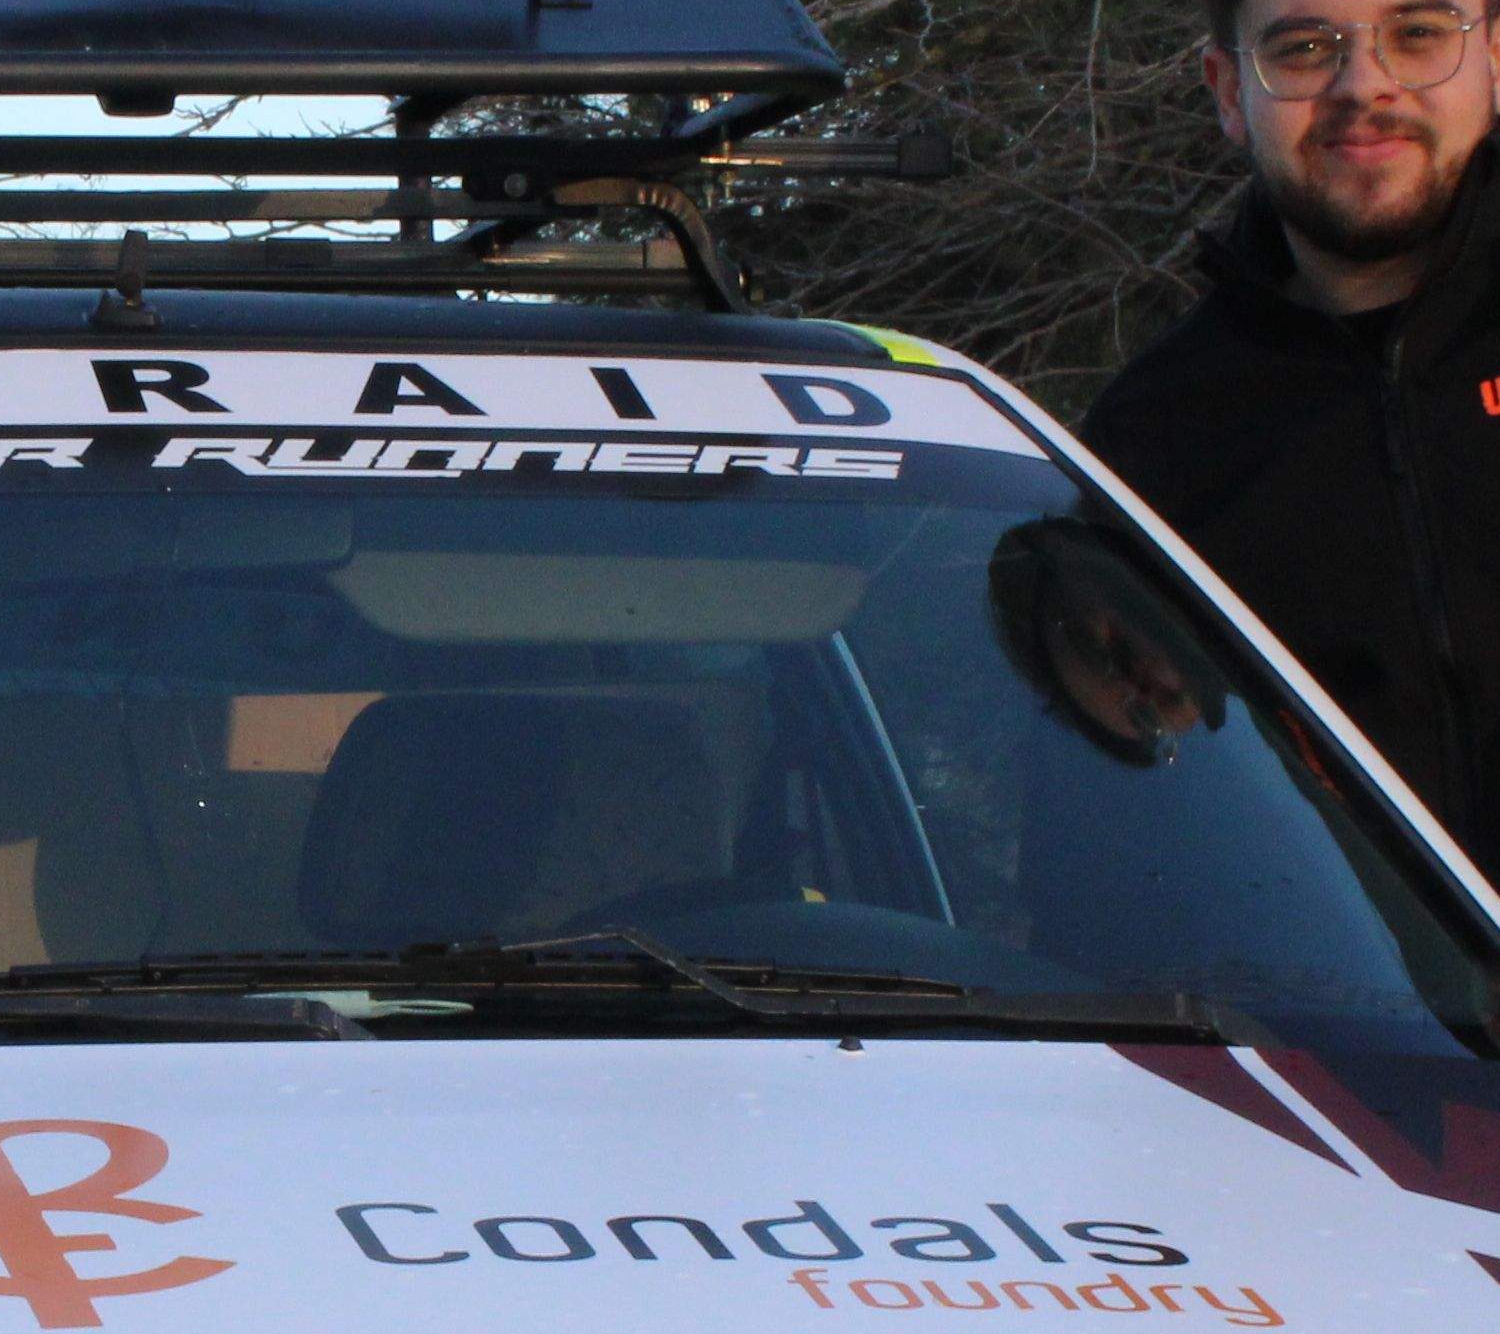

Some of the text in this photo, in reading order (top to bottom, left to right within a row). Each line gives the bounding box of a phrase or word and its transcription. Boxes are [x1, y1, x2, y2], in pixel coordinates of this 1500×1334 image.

[151, 437, 904, 479] RUNNERS
[334, 1199, 1191, 1267] Condals
[788, 1267, 1287, 1328] foundry
